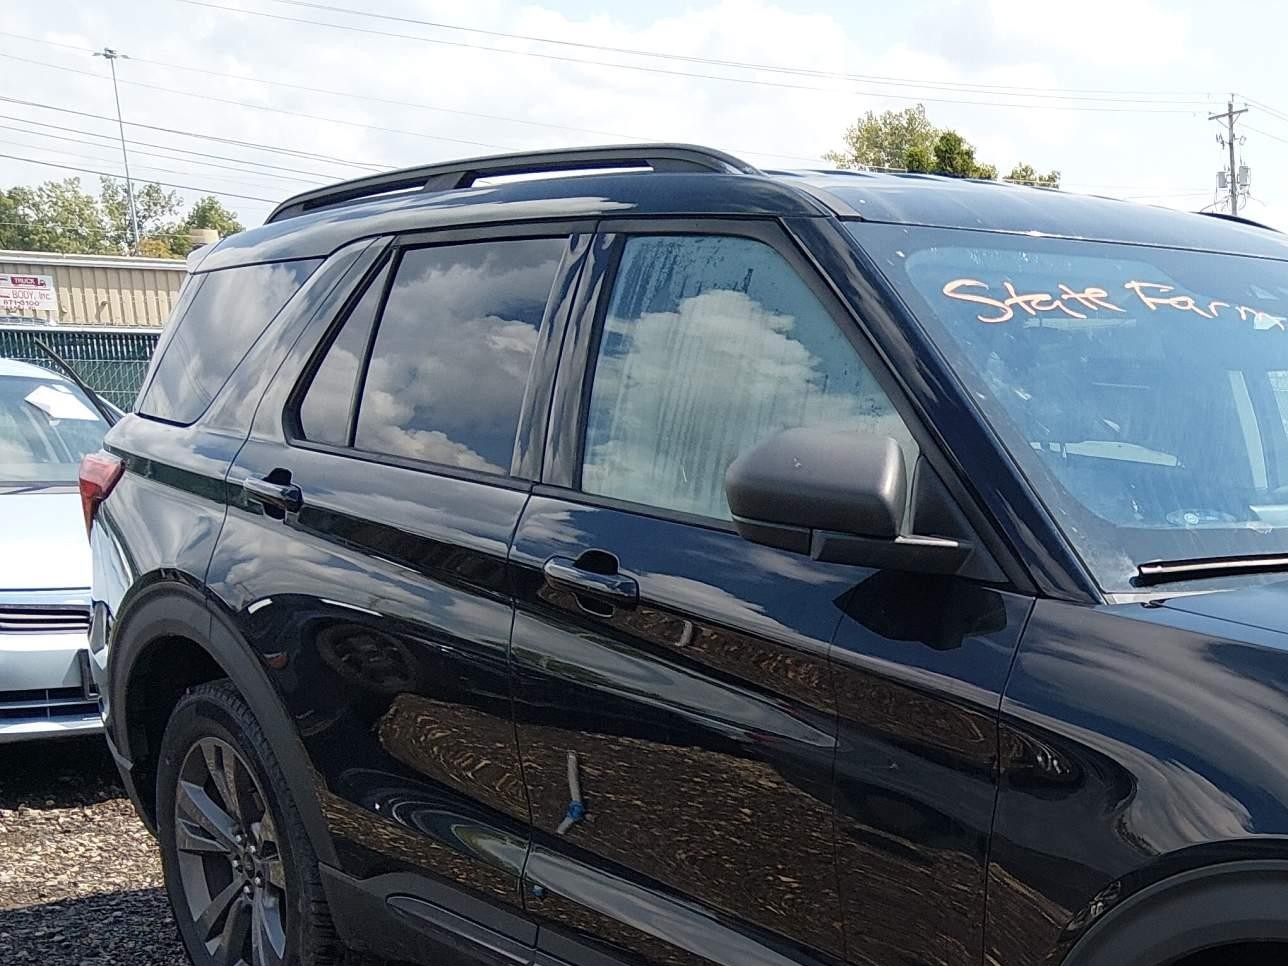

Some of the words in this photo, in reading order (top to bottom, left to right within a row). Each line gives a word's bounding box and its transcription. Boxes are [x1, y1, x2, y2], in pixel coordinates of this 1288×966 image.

[14, 277, 35, 285] TRUCK
[943, 279, 1127, 323] State
[1124, 280, 1287, 331] Farm
